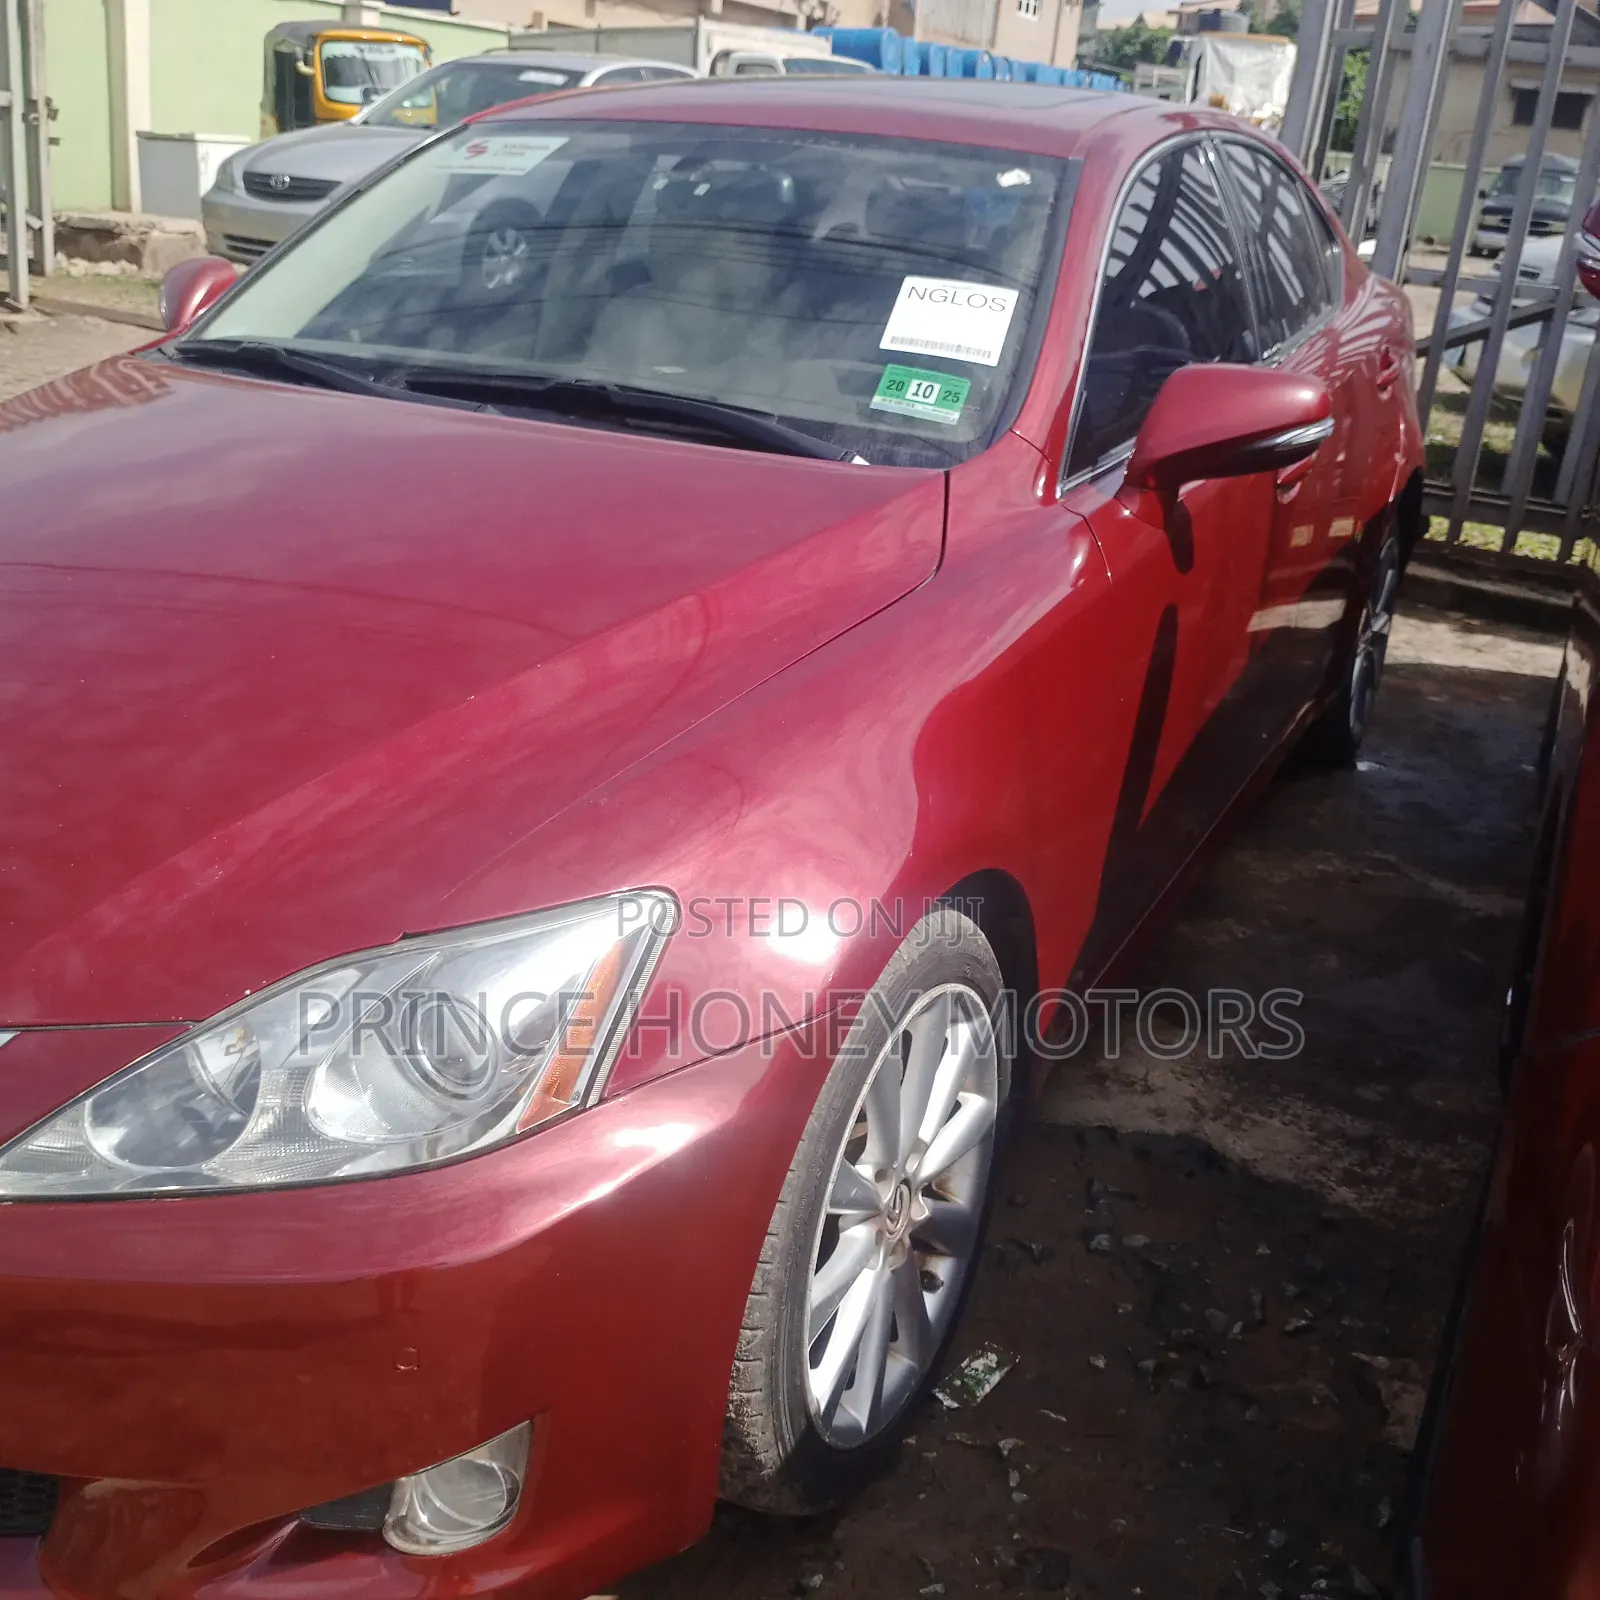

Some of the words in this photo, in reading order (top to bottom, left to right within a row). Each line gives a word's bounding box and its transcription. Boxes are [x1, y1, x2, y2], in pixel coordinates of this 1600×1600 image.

[907, 286, 1007, 312] NGLOS
[886, 380, 905, 392] 20
[912, 382, 935, 399] 10
[943, 390, 961, 404] 25
